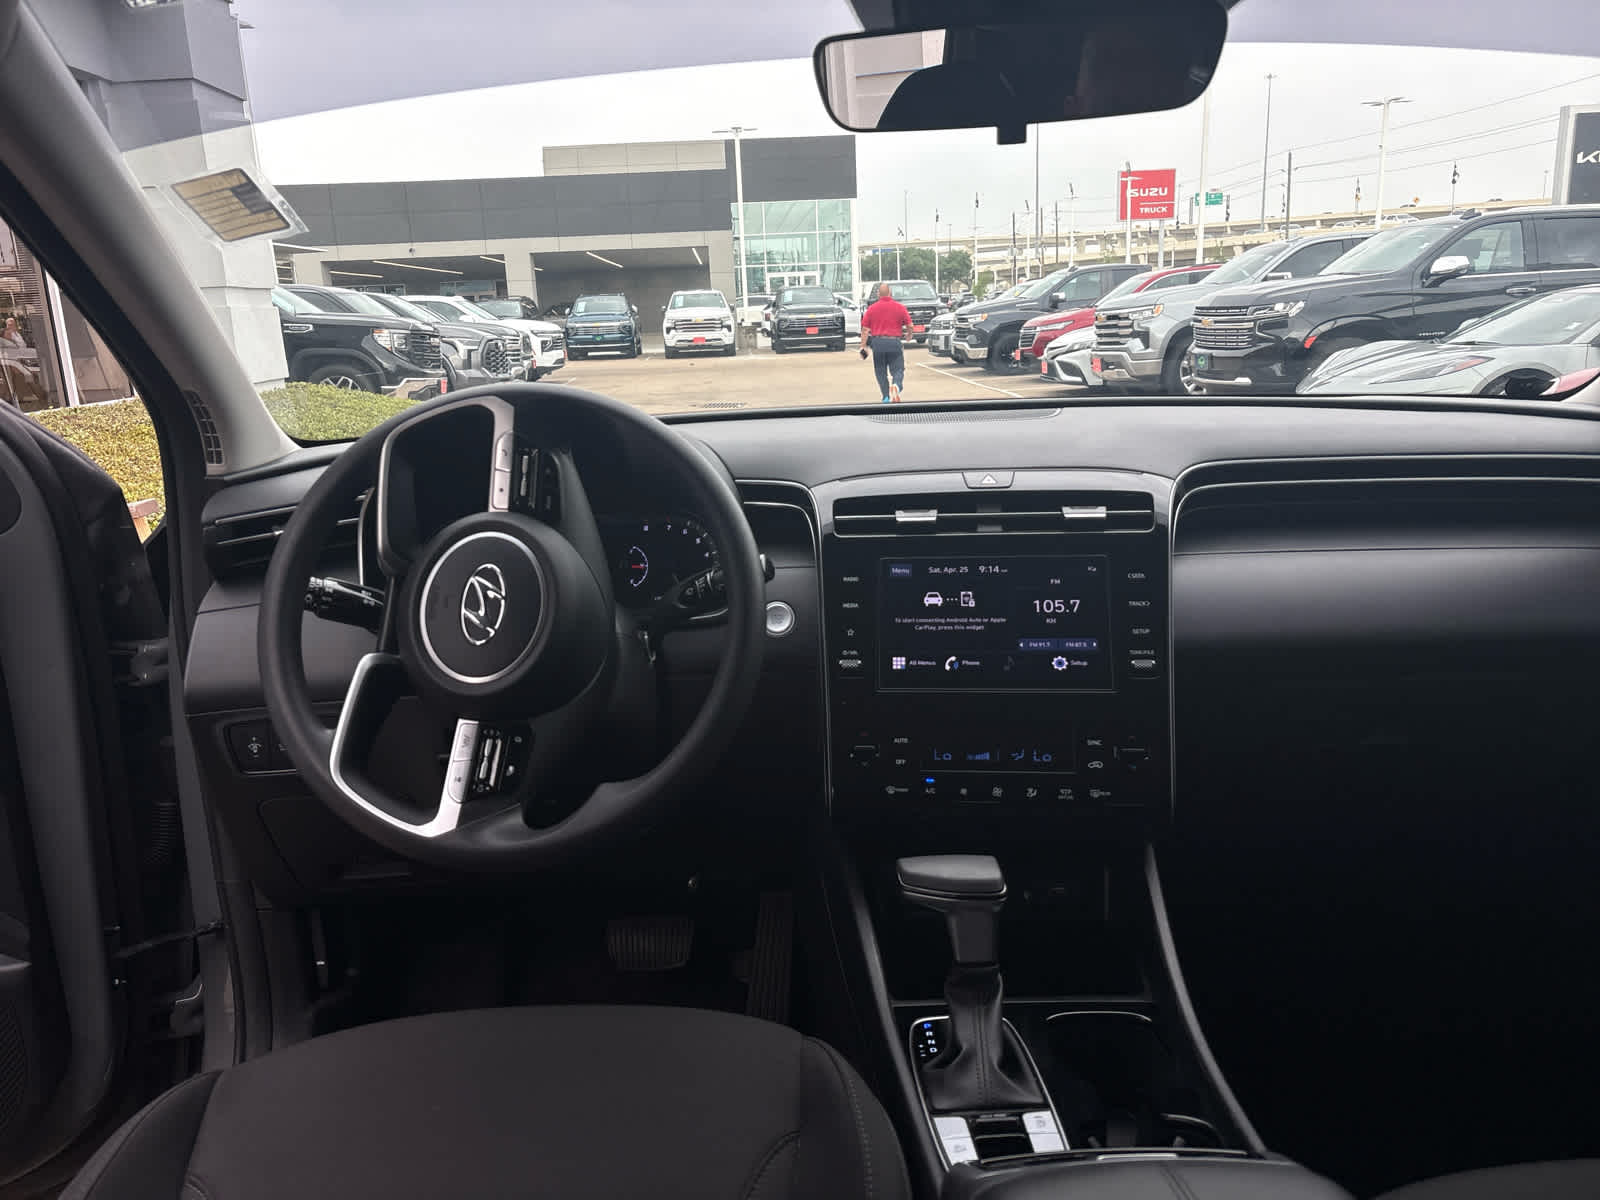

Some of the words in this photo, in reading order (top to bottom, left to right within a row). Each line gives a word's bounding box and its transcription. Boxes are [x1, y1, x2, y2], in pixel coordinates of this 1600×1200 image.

[1127, 187, 1168, 197] SUZU
[1139, 206, 1168, 214] TRUCK
[979, 565, 1000, 573] 9:14
[1033, 599, 1080, 613] 105.7
